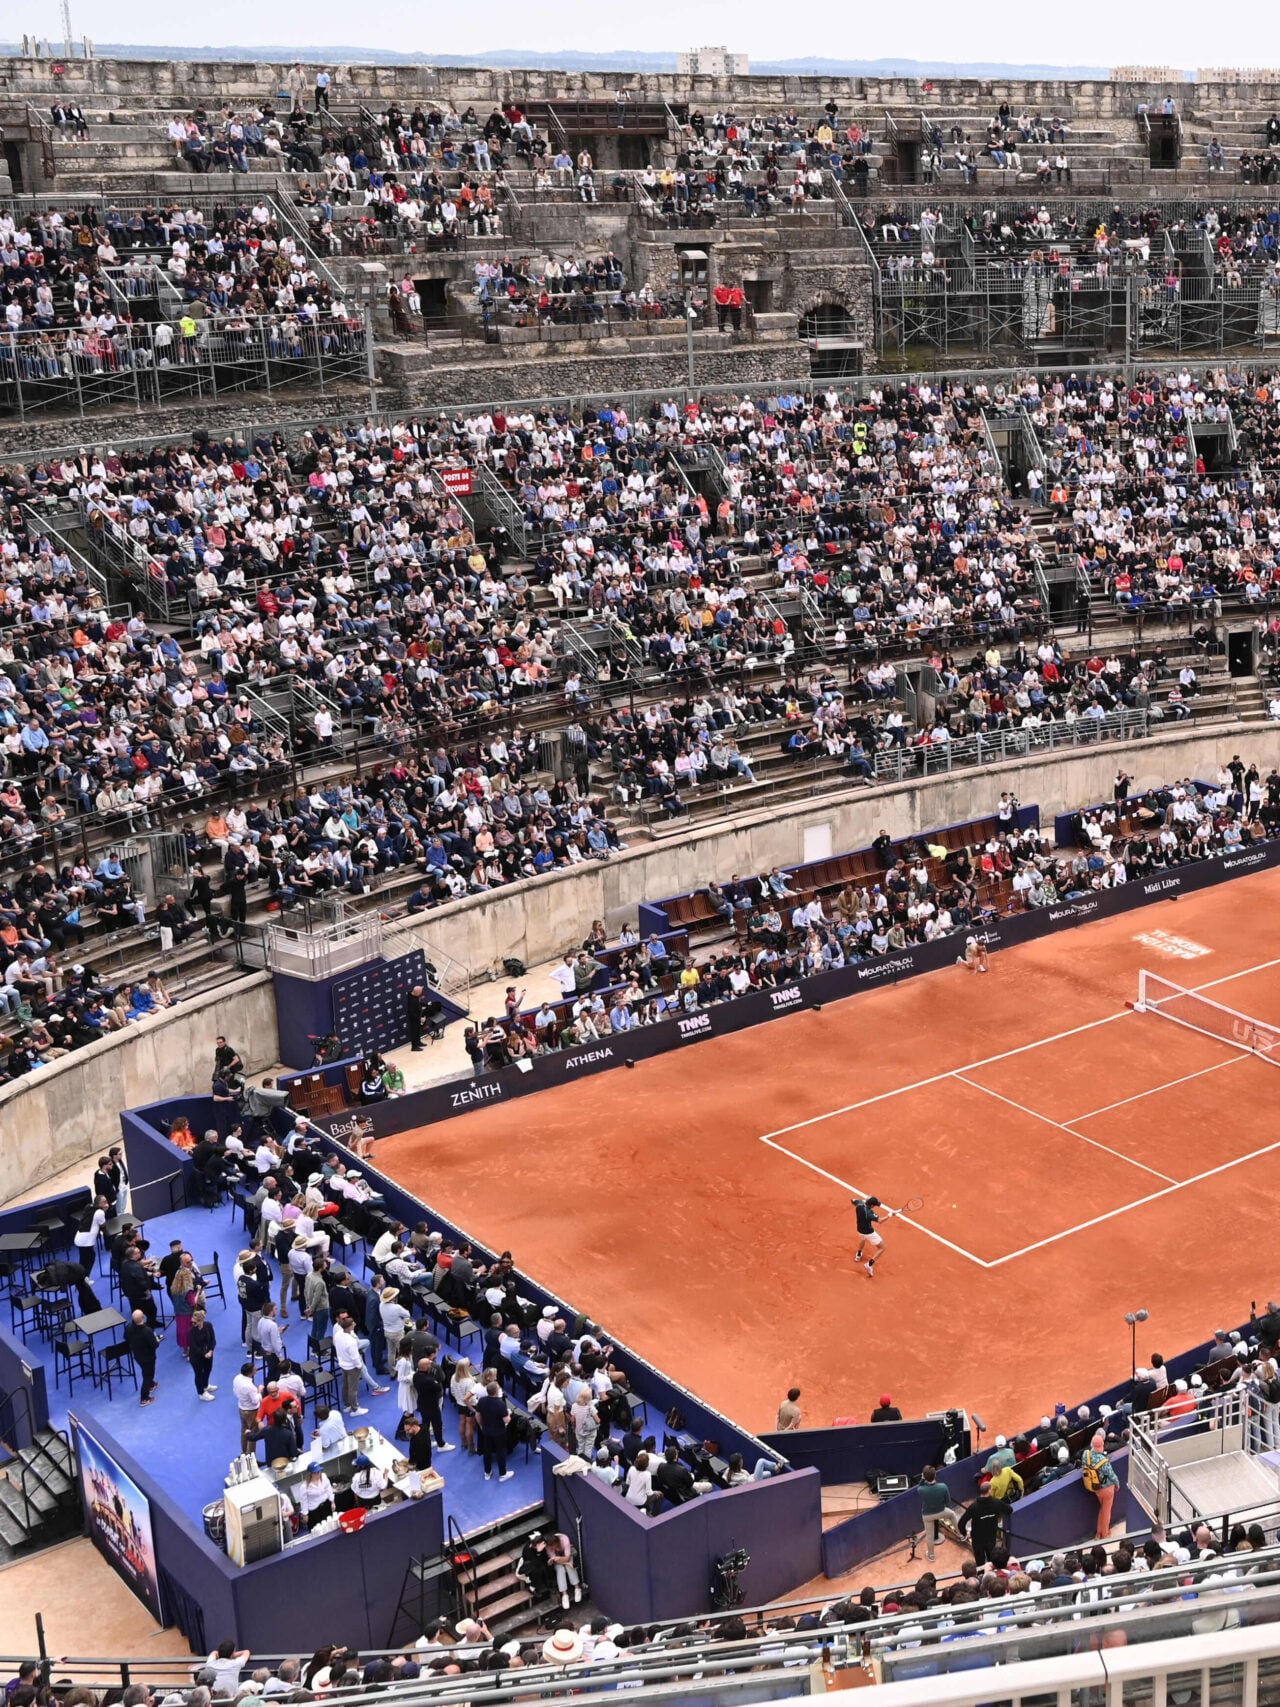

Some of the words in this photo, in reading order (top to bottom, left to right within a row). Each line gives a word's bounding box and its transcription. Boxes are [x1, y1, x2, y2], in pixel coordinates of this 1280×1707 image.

[443, 473, 460, 482] POSTE
[461, 472, 469, 480] DE
[1143, 882, 1161, 894] Midi
[1161, 878, 1181, 889] Libre
[770, 986, 801, 1005] TNNS
[677, 1013, 710, 1033] TNNS
[565, 1047, 614, 1070] ATHENA
[450, 1082, 502, 1107] ZENITH
[330, 1114, 373, 1136] Bastie
